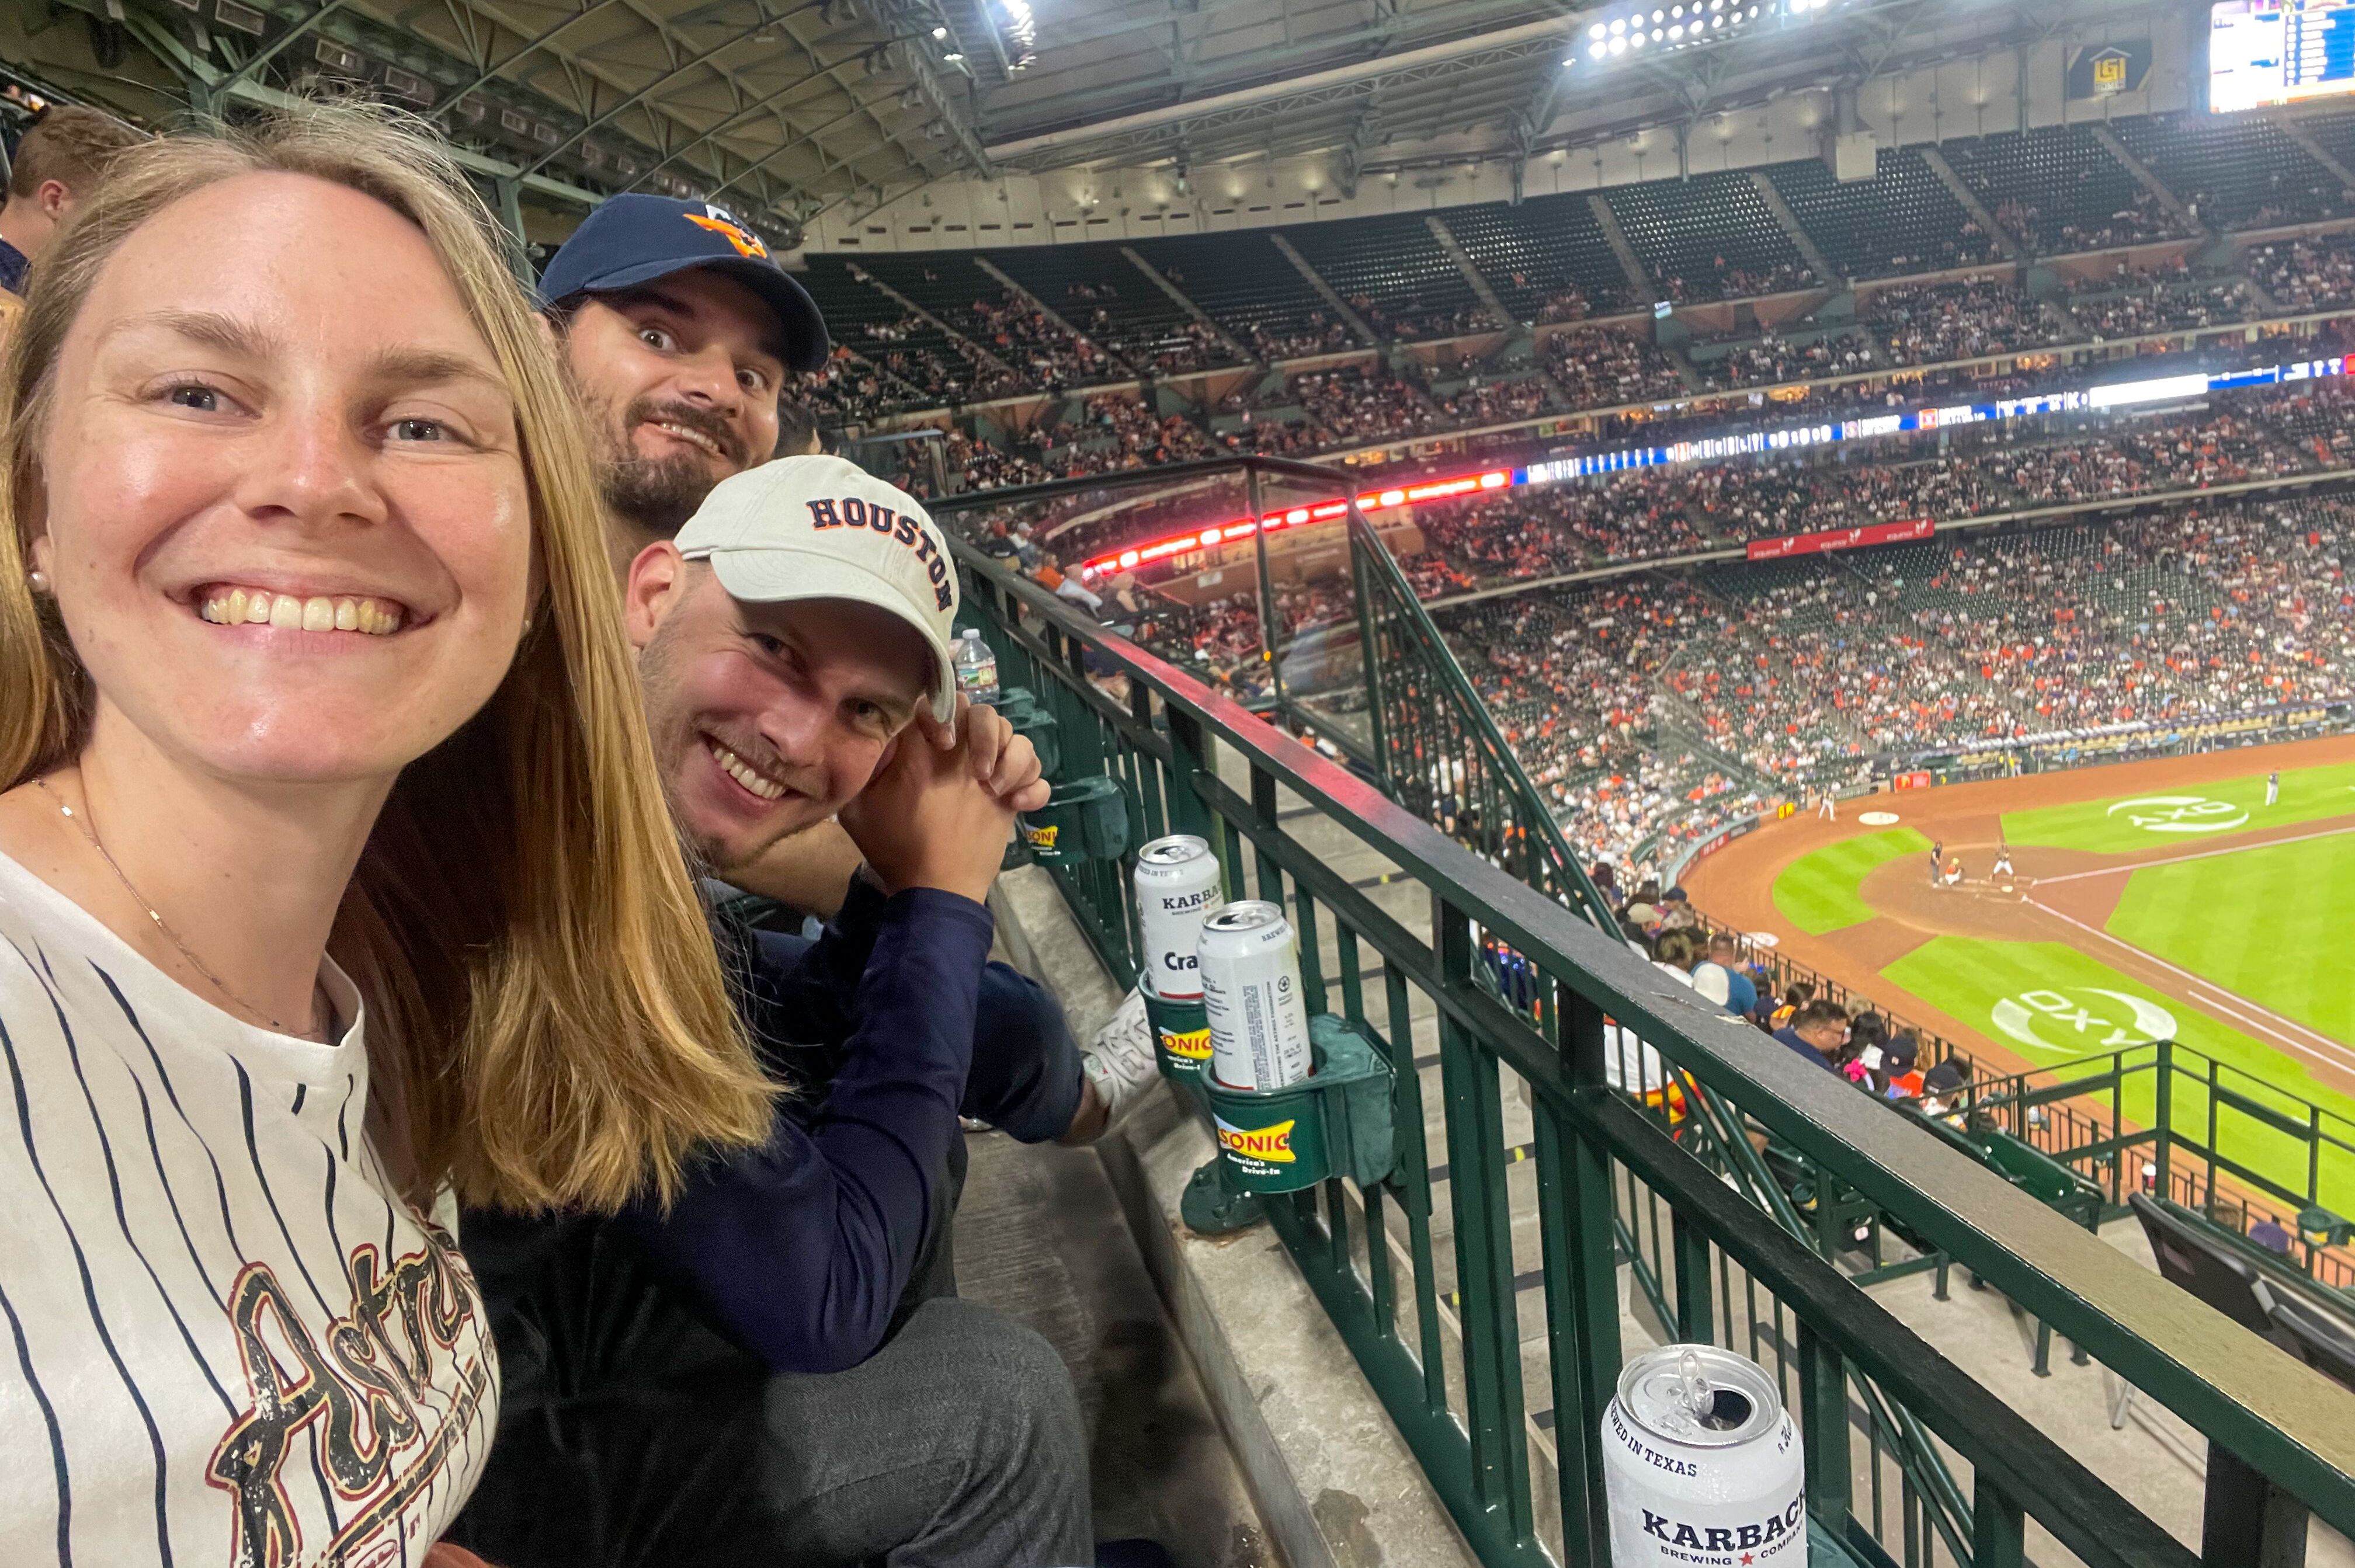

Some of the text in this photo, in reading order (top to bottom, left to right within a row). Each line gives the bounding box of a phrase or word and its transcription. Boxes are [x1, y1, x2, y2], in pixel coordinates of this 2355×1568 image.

[806, 498, 952, 611] HOUSTON
[1162, 881, 1221, 909] KARBA
[1163, 1034, 1212, 1051] ONIC
[1219, 1128, 1289, 1152] SONIC
[206, 1229, 474, 1568] Astro
[1627, 1436, 1643, 1455] IN
[1645, 1448, 1697, 1477] TEXAS
[1661, 1545, 1732, 1566] BREWING
